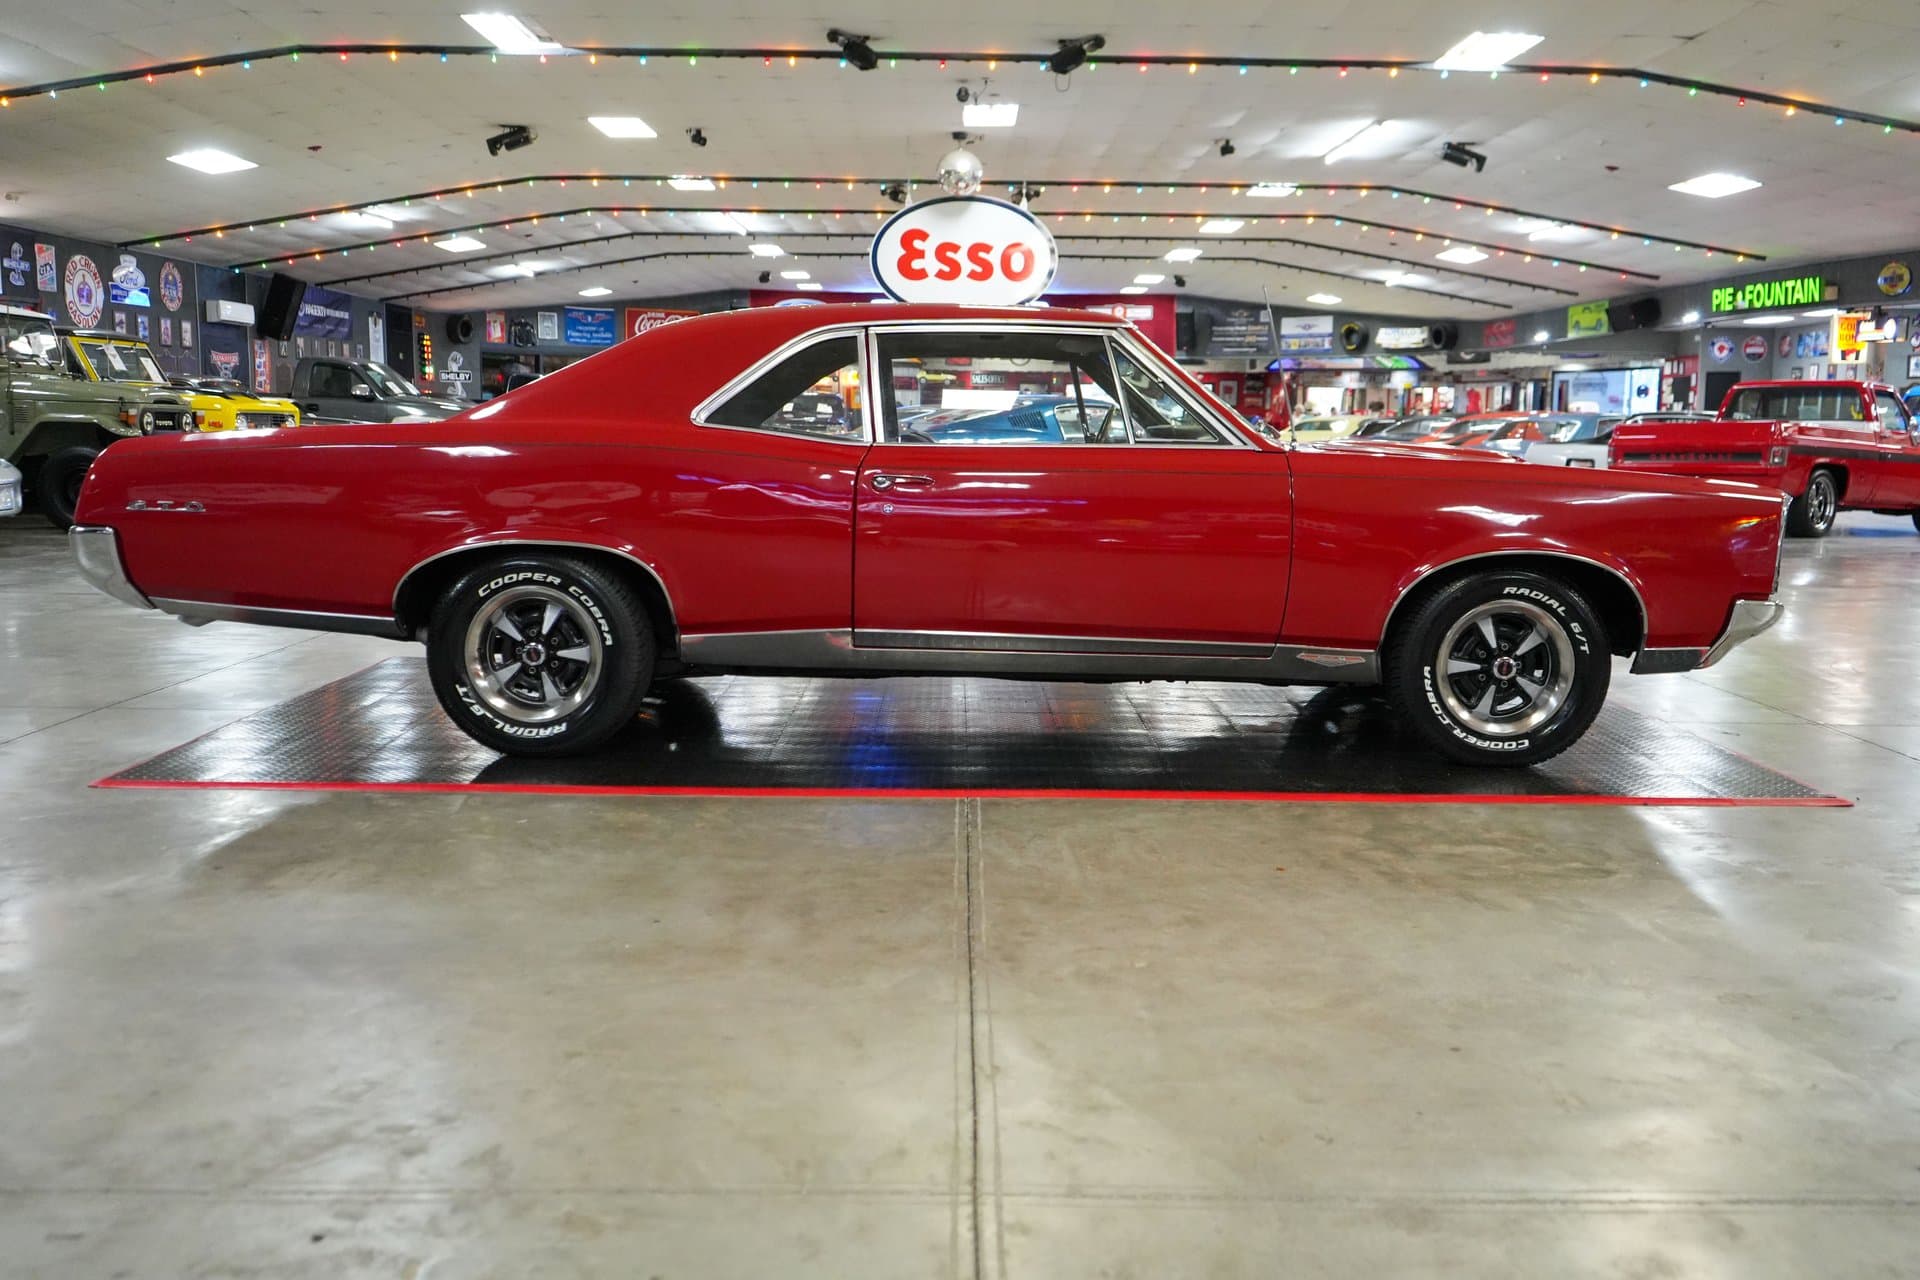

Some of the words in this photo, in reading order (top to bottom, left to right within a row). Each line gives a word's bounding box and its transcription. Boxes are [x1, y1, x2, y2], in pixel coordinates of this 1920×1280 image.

[66, 260, 77, 284] RED
[120, 271, 140, 286] Ford
[1712, 287, 1735, 312] PIE
[1745, 277, 1820, 309] FOUNTAIN
[478, 572, 562, 598] COOPER
[568, 585, 613, 646] COBRA
[1503, 586, 1567, 617] RADIAL
[1423, 666, 1450, 725] COBRA
[494, 718, 567, 738] RADIAL
[1453, 728, 1529, 749] COOPER
